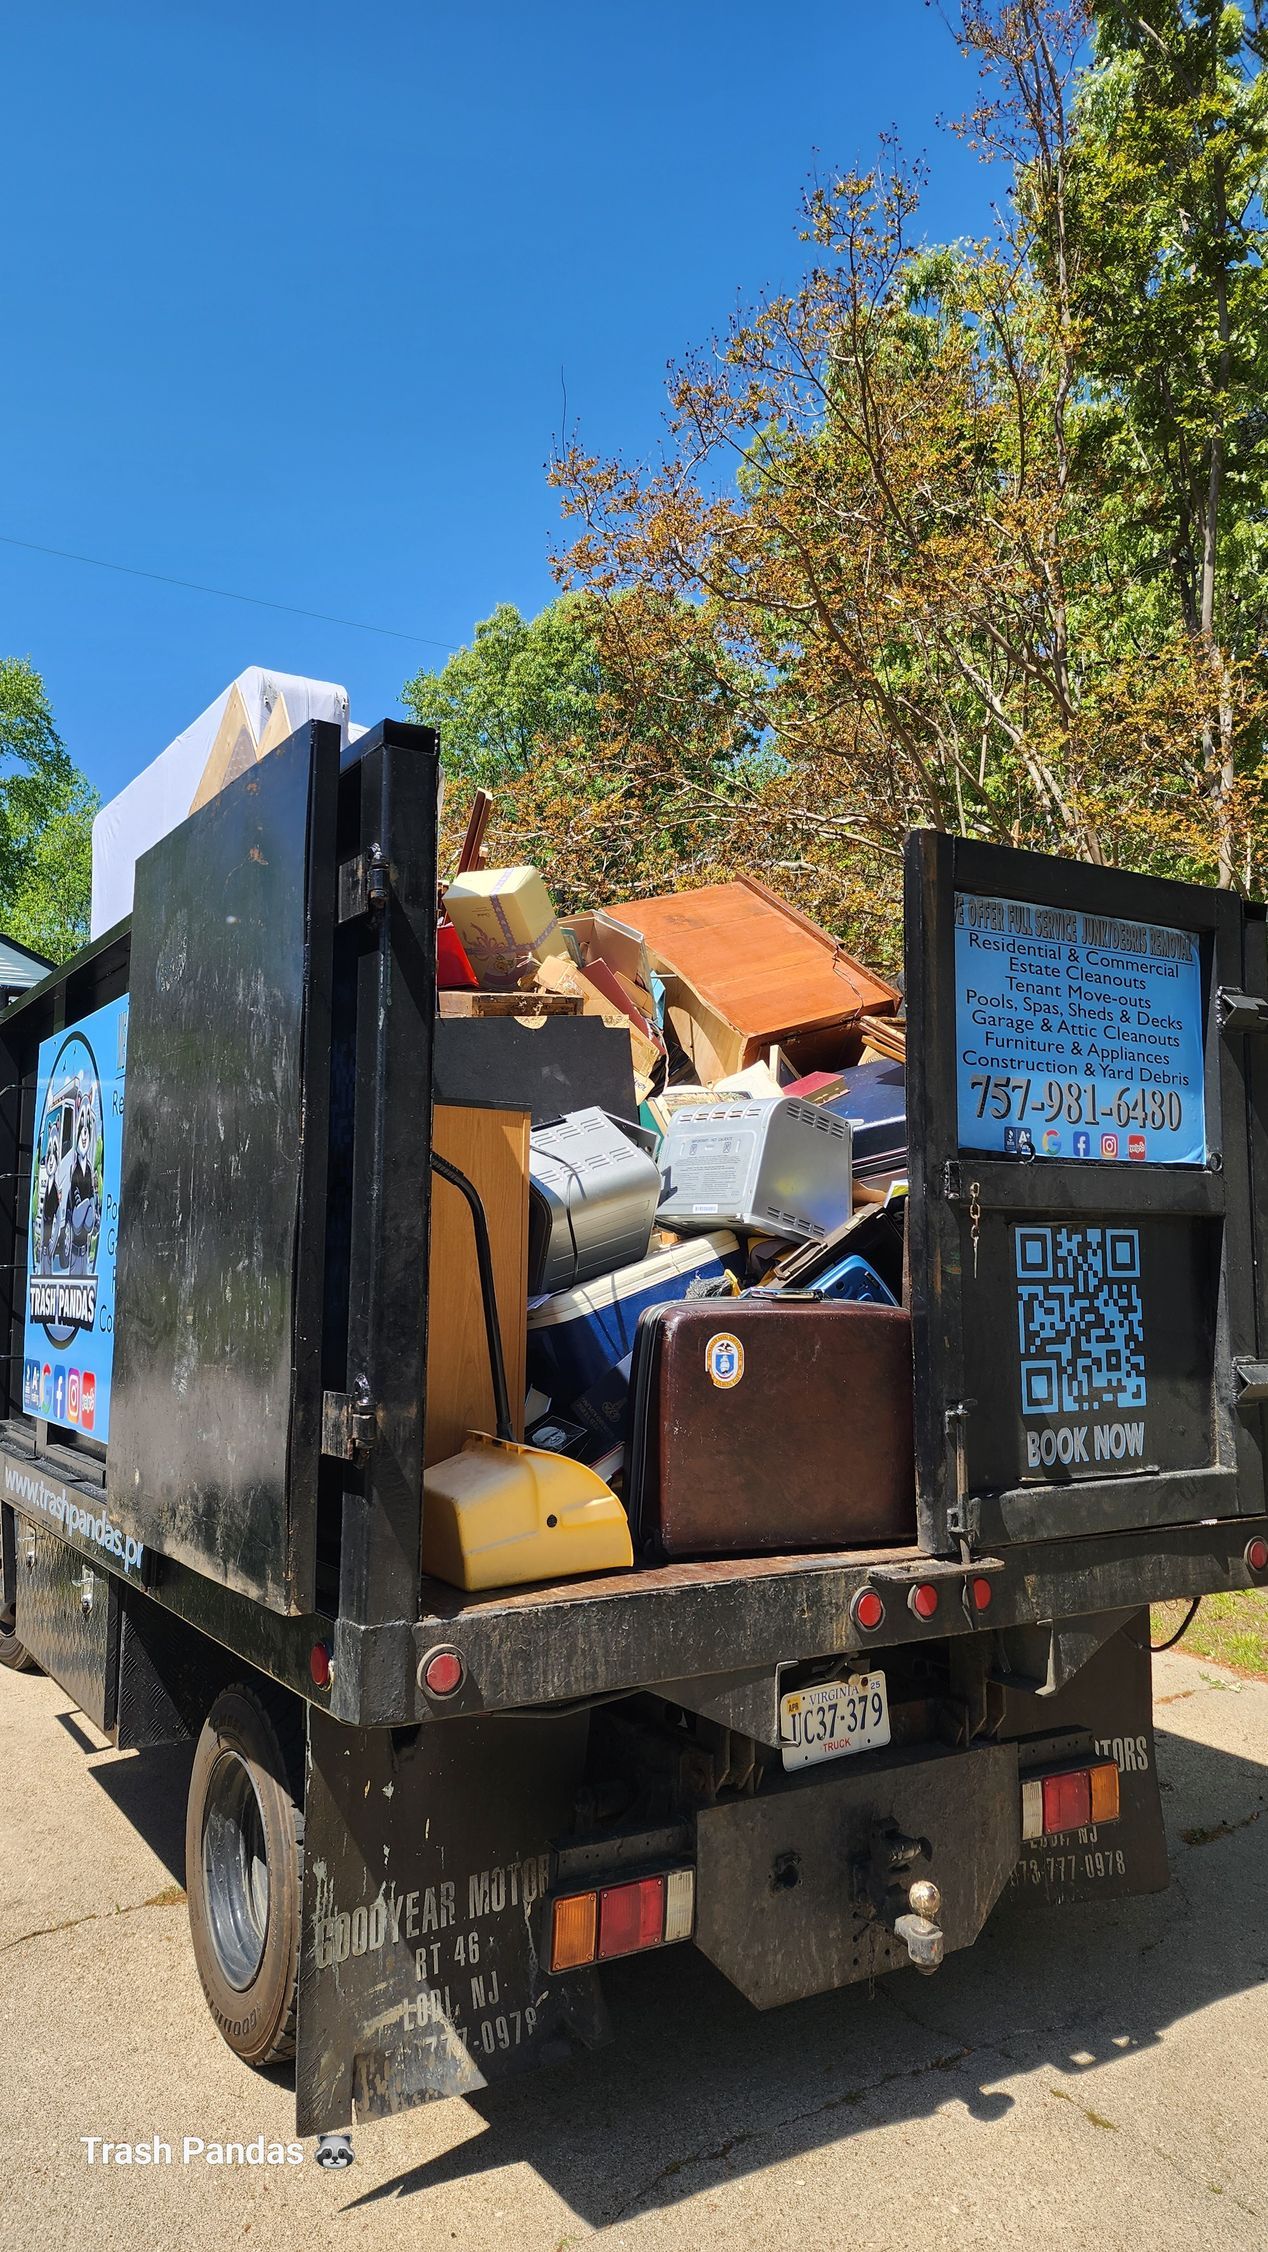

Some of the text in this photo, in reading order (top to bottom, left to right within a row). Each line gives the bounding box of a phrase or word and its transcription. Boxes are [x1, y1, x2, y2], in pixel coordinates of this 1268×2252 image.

[968, 898, 1004, 932] OFFER
[1007, 904, 1033, 937] FULL
[1035, 908, 1078, 944] SERVICE
[1081, 916, 1148, 954] JUNK/DEBRIS
[1150, 927, 1193, 962] REMOVAL
[969, 932, 1179, 978] Residential & Commercial
[1009, 956, 1147, 990] Estate Cleanouts
[966, 989, 1183, 1031] Pools, Spas, Sheds & Decks
[1005, 976, 1151, 1009] Tenant Move-outs
[972, 1009, 1180, 1048] Garage & Attic Cleanouts
[985, 1031, 1170, 1065] Furniture & Appliances
[962, 1050, 1190, 1086] Construction & Yard Debris
[970, 1074, 1182, 1132] 757-981-6480
[30, 1287, 56, 1318] TRASH
[58, 1287, 95, 1324] PANDAS
[1027, 1422, 1145, 1468] BOOK NOW
[5, 1466, 143, 1574] www.trashpandas.pr
[809, 1681, 882, 1705] VIRGINIA 25
[823, 1738, 852, 1753] TRUCK
[1095, 1736, 1149, 1773] TORS
[315, 1881, 456, 1969] GOODYEAR
[415, 1931, 480, 1982] RT 46
[470, 1970, 500, 2010] NJ
